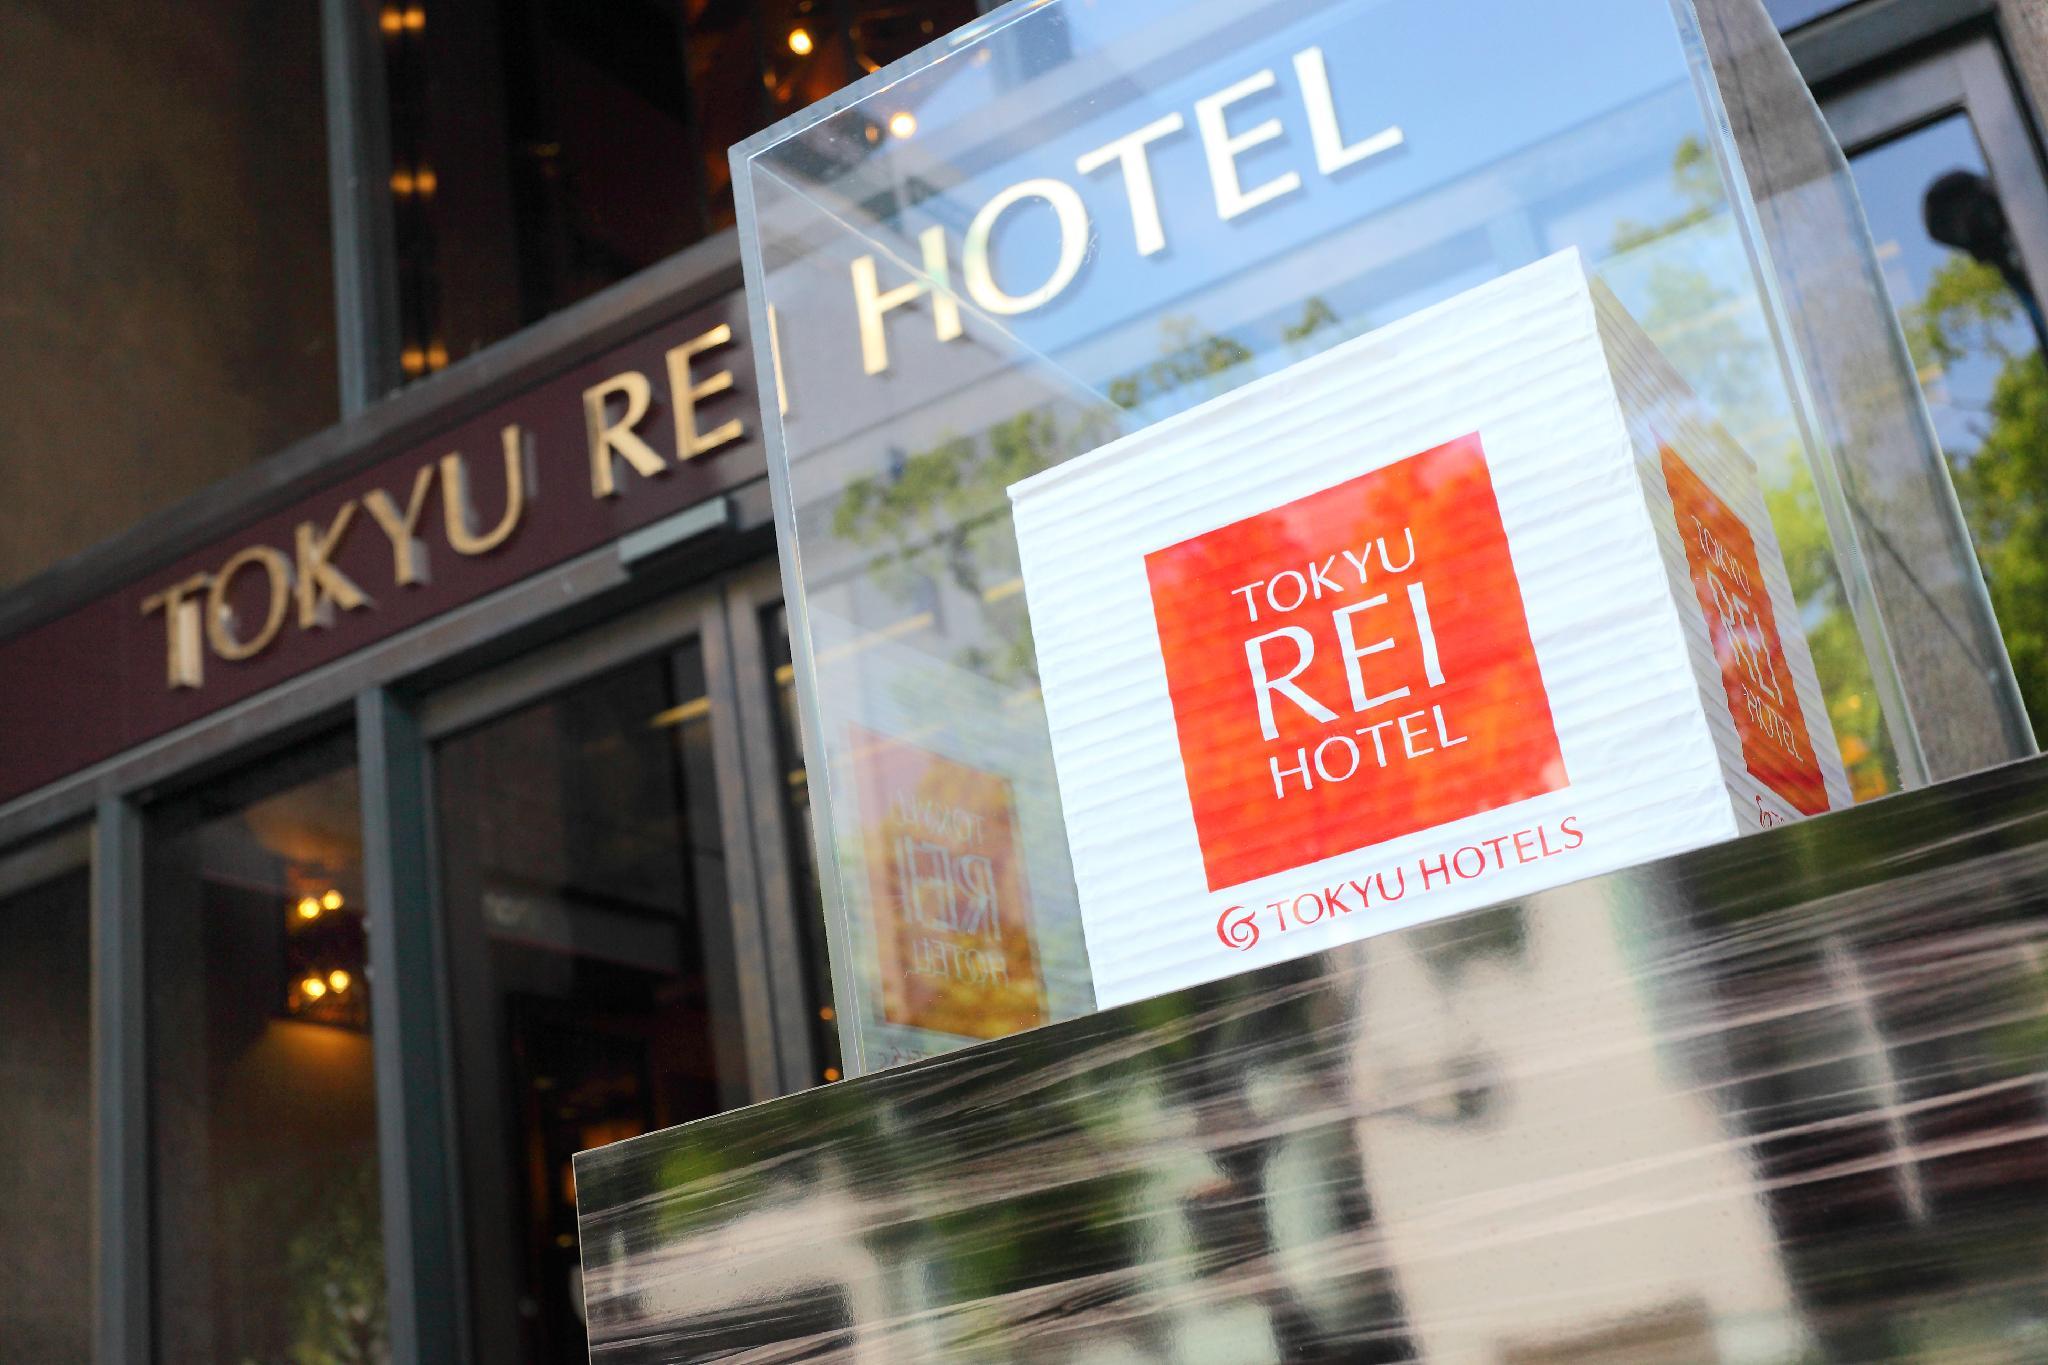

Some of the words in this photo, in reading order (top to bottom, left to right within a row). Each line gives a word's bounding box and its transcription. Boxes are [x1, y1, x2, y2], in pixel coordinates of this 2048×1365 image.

[140, 424, 525, 689] TOKYU
[850, 45, 1404, 376] HOTEL
[1231, 526, 1417, 623] TOKYU
[1690, 514, 1752, 597] TOKYU
[1243, 580, 1447, 742] REI
[1268, 703, 1469, 800] HOTEL
[1740, 682, 1804, 763] HOTEL
[1266, 865, 1406, 933] TOKYU
[1418, 815, 1585, 891] HOTELS
